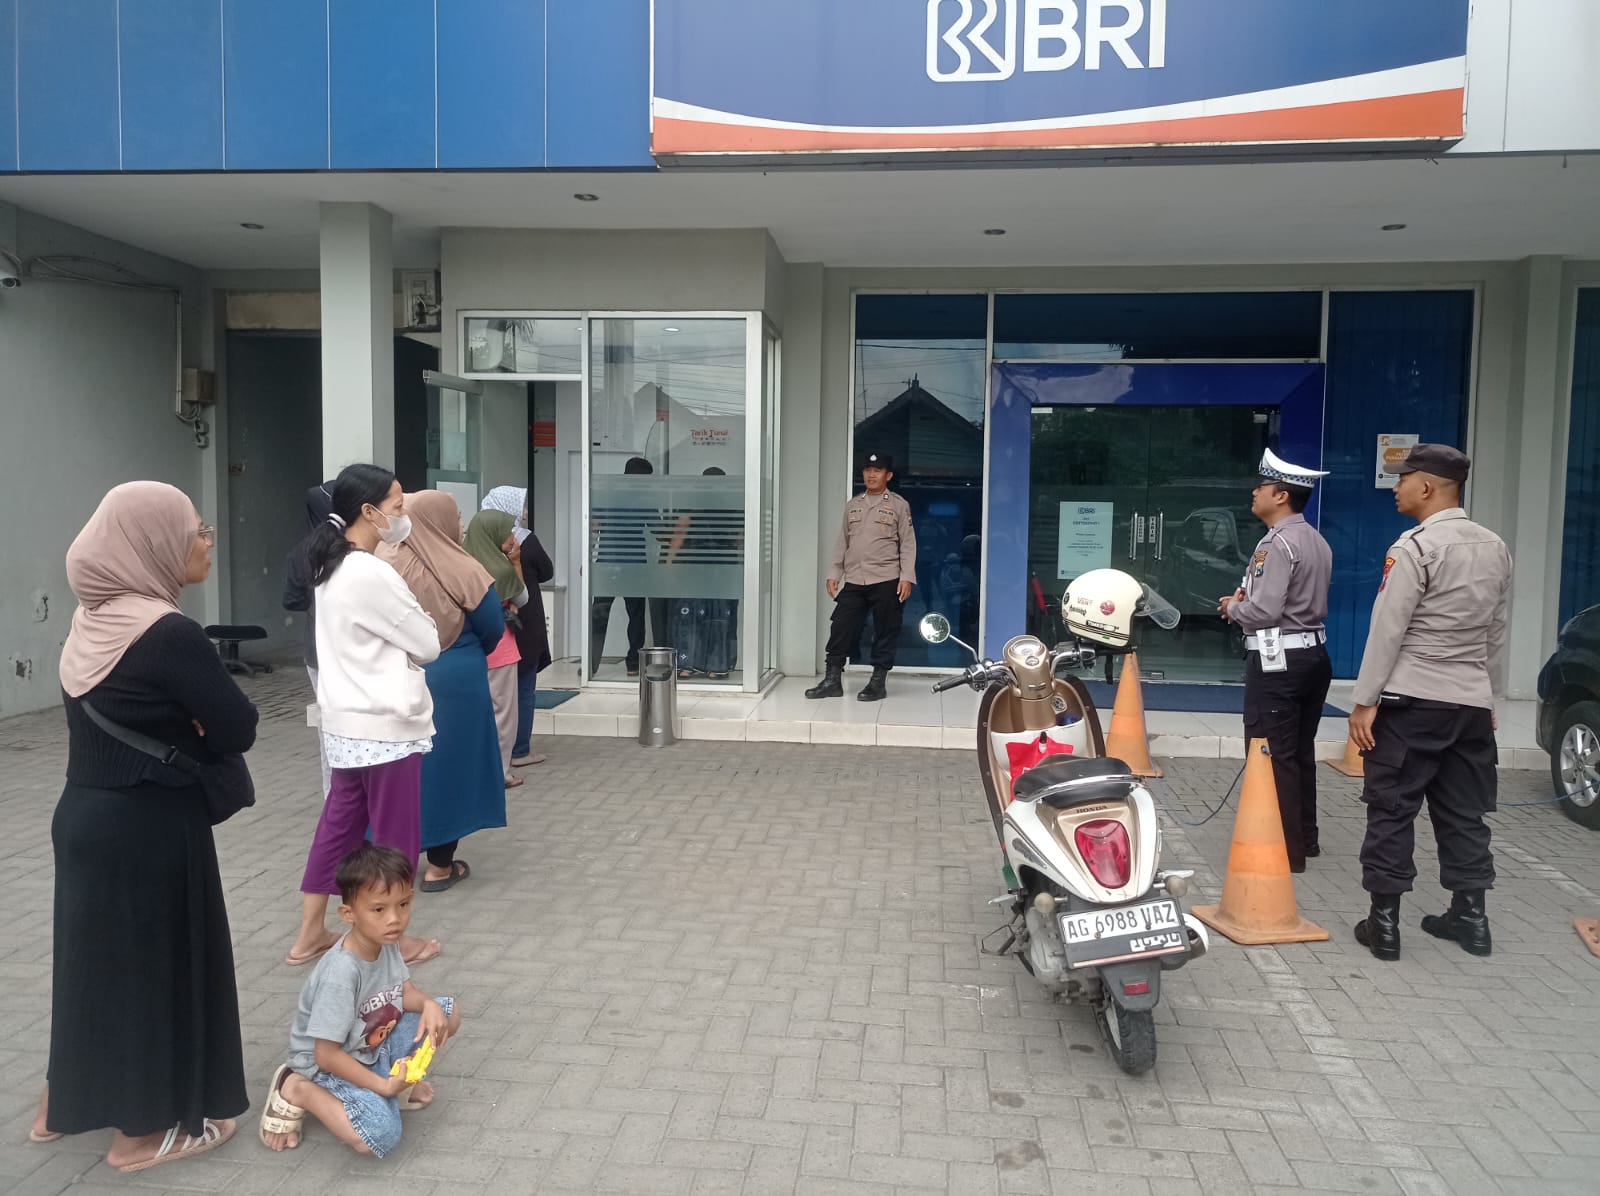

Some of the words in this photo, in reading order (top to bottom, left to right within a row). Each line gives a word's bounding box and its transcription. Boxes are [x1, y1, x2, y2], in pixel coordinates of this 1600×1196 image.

[1023, 0, 1167, 72] BRI
[1076, 805, 1108, 814] HONDA
[1067, 919, 1090, 939] AG
[1095, 910, 1138, 934] 6988
[1140, 903, 1176, 930] VAZ
